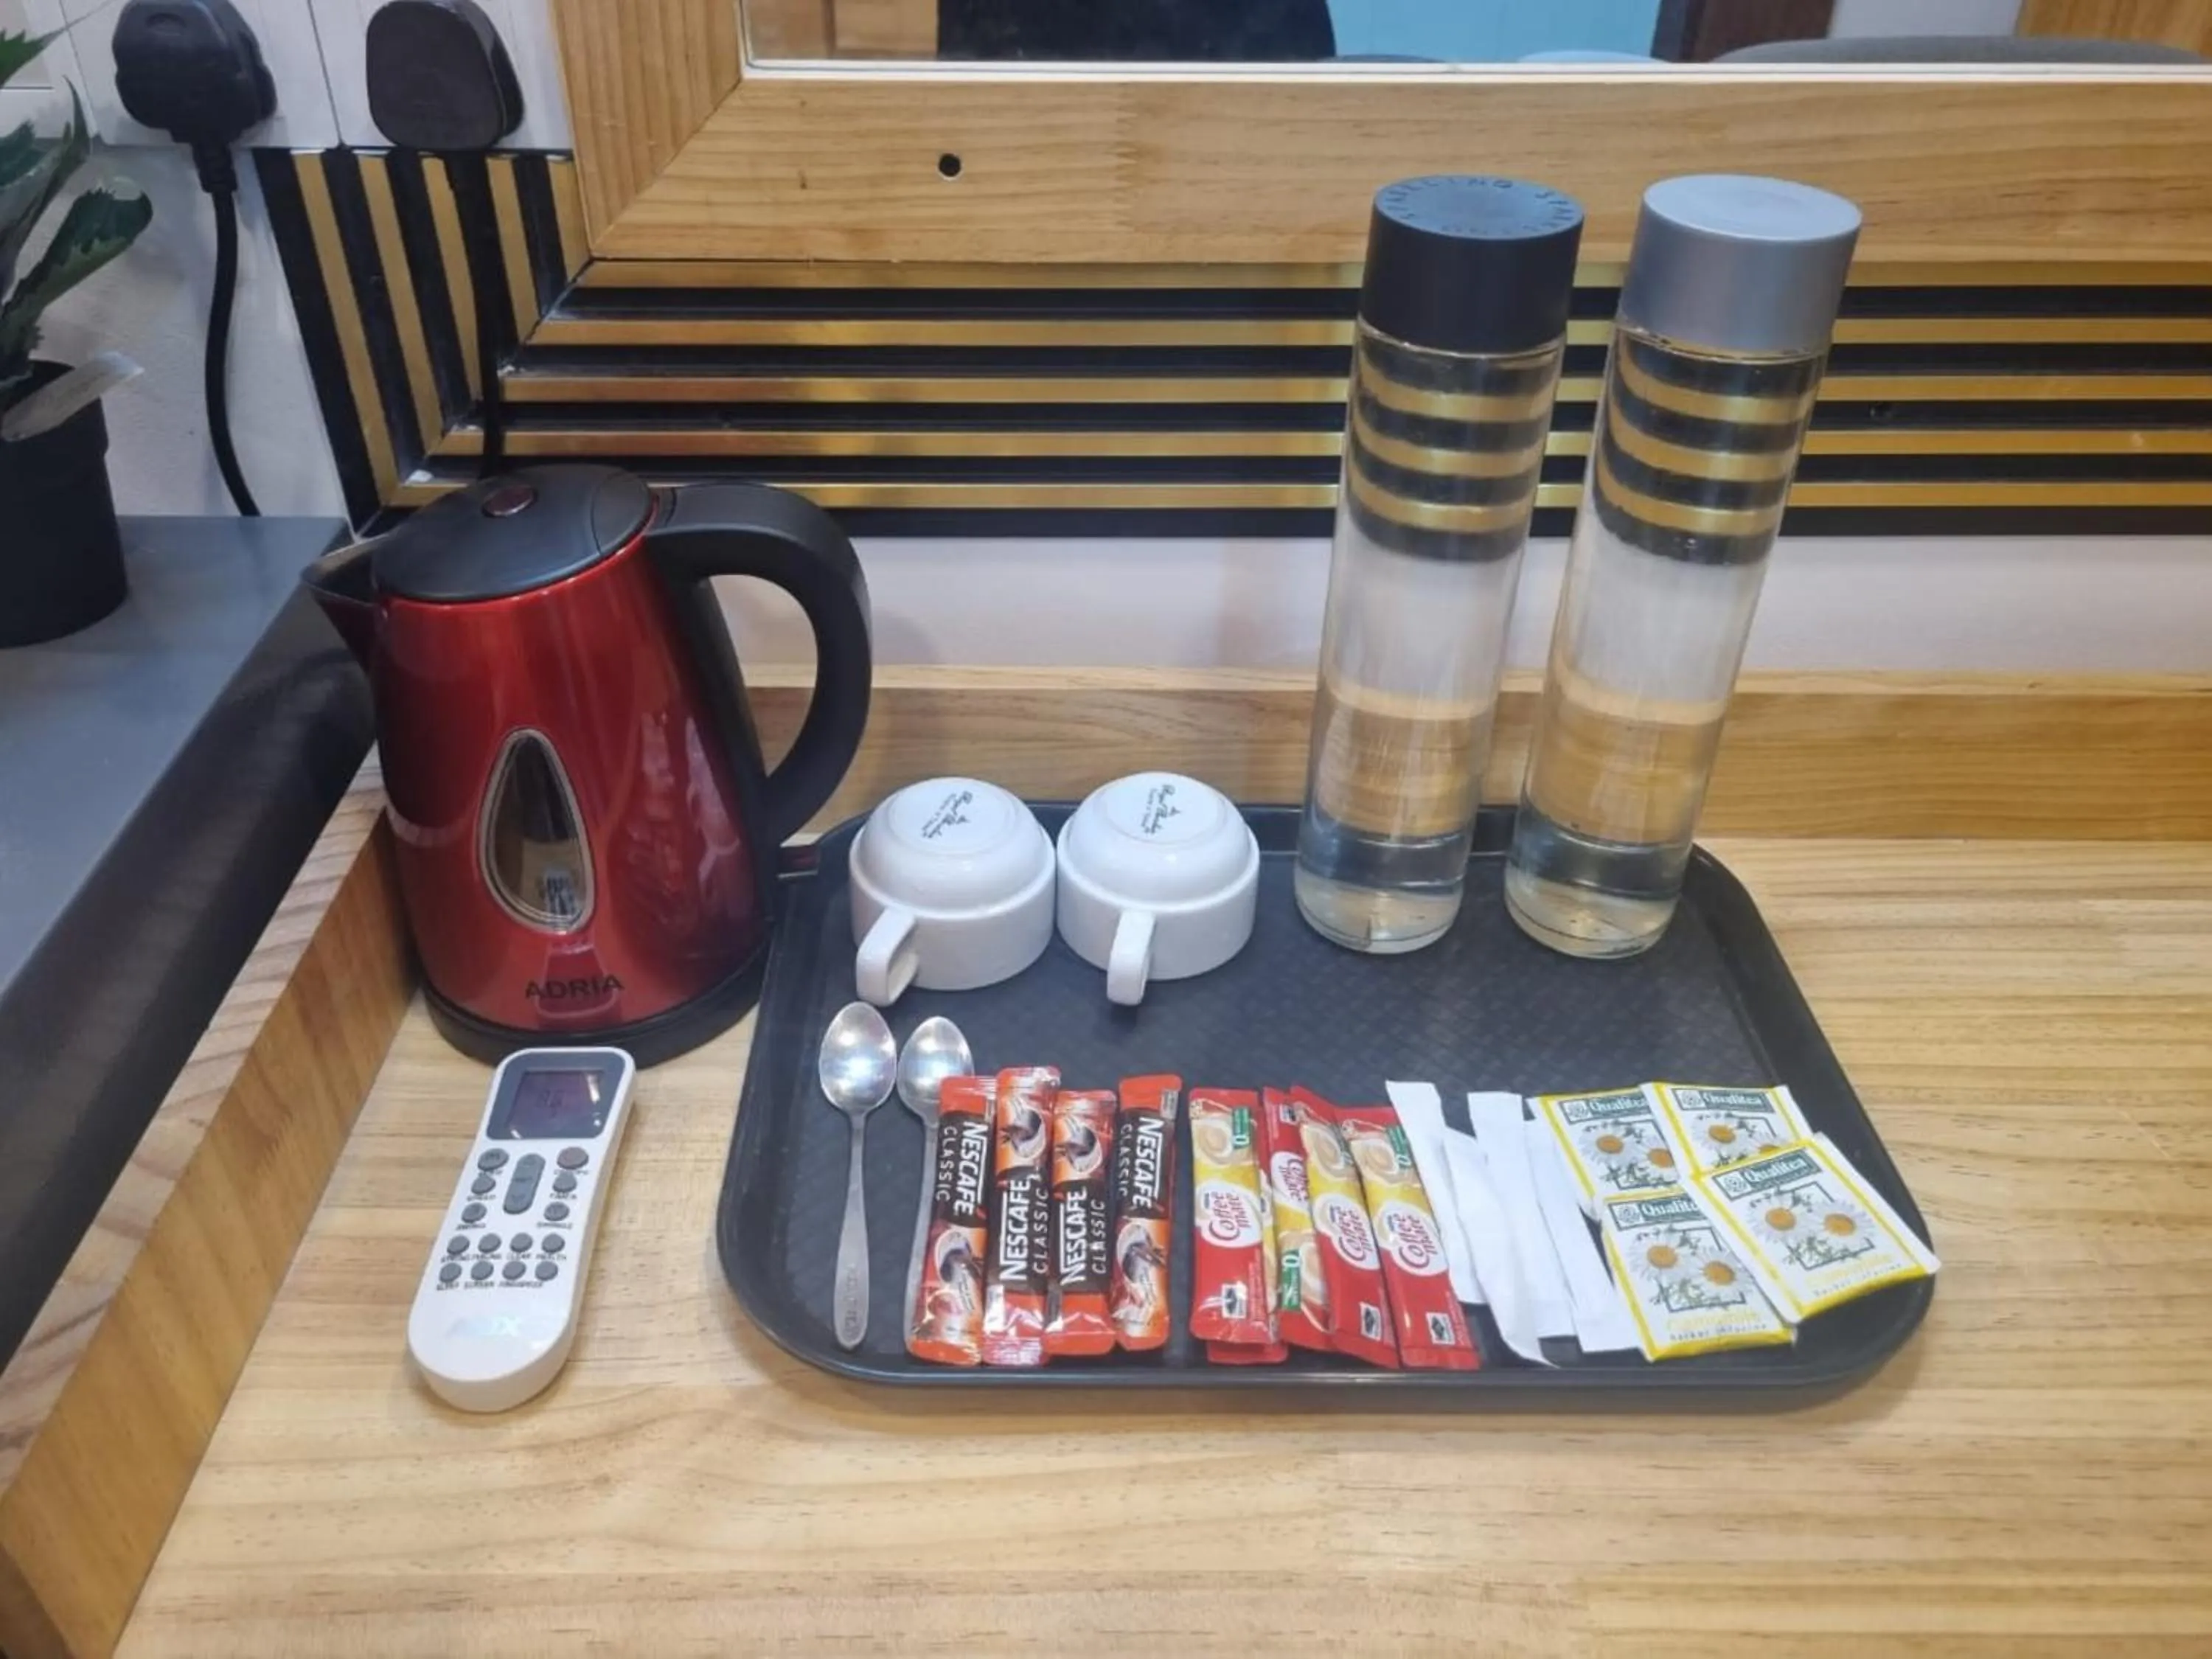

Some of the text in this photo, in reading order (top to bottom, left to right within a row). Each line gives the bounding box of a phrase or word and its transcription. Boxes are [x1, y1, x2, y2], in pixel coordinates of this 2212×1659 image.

[525, 974, 625, 999] ADRIA
[936, 1125, 958, 1202] CLASSIC
[1119, 1123, 1133, 1197] CLASSIC
[1743, 1158, 1808, 1183] Qualitea
[1033, 1187, 1050, 1274] CLASSIC
[1090, 1199, 1107, 1275] CLASSIC
[1641, 1200, 1699, 1217] Qualite
